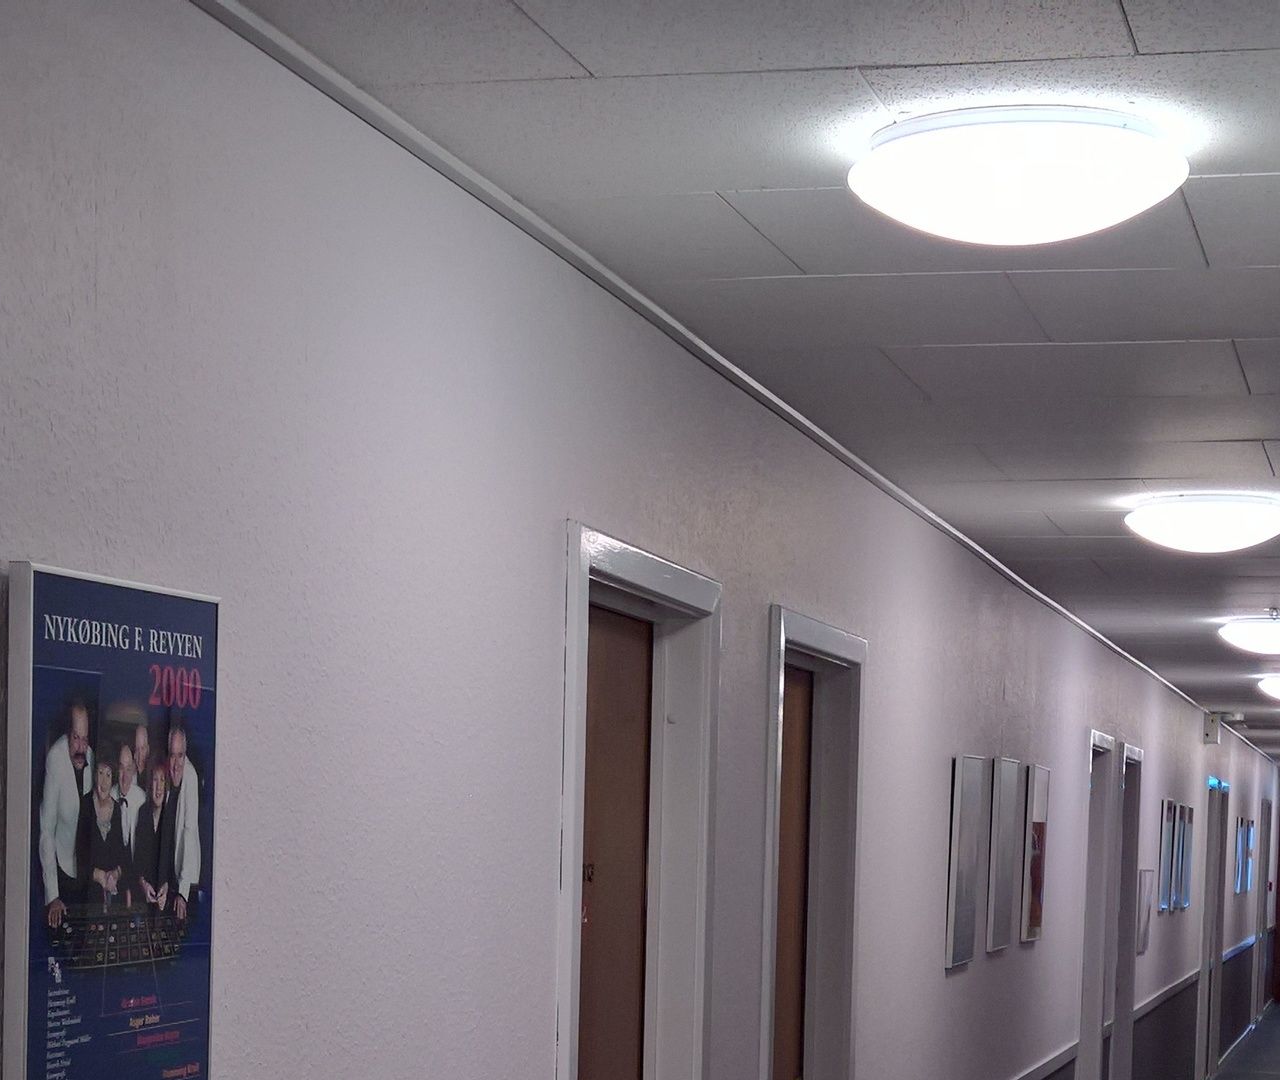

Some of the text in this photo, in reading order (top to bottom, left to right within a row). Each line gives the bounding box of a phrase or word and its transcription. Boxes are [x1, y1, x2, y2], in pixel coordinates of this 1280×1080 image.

[43, 613, 203, 660] NYKØBING F. REVYEN
[148, 663, 202, 710] 2000
